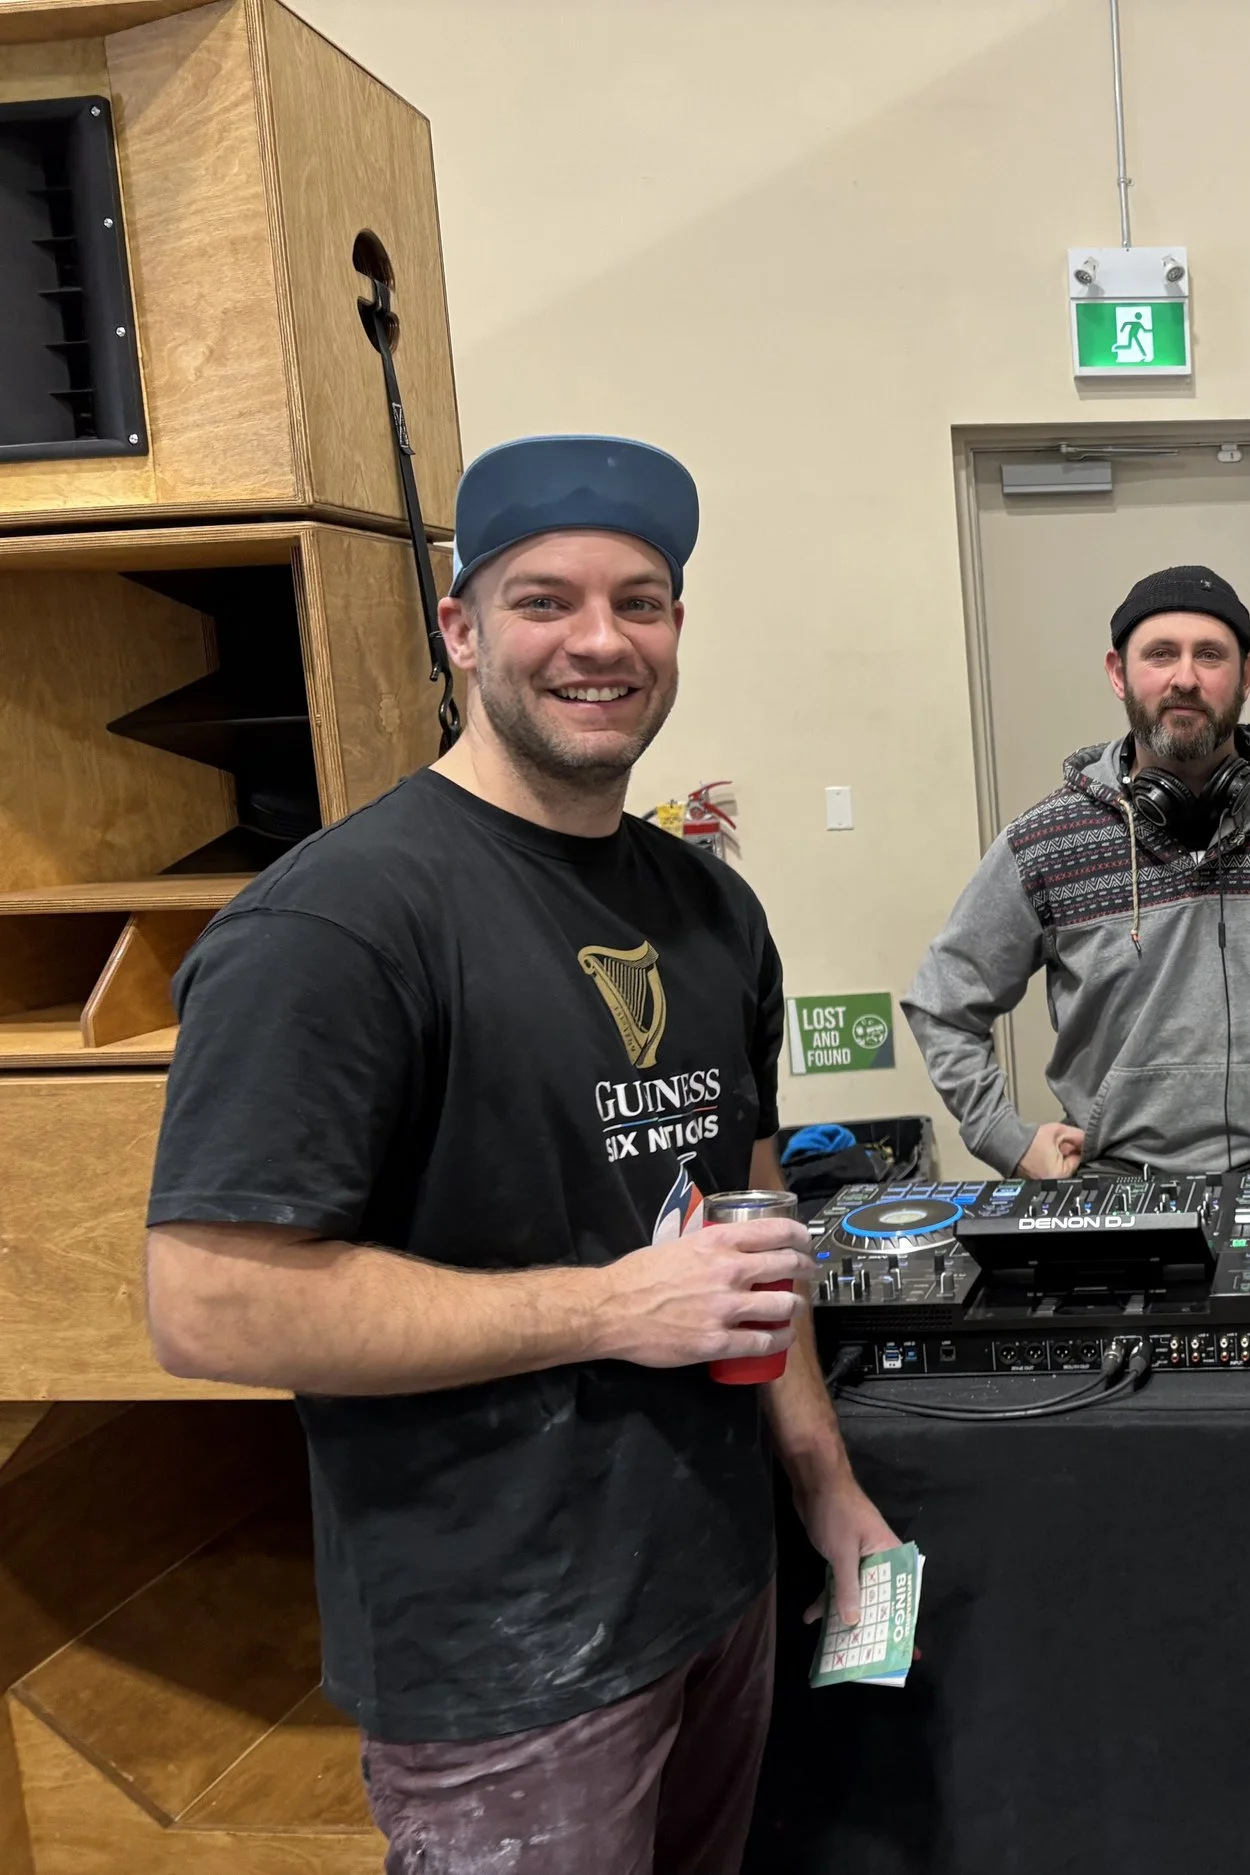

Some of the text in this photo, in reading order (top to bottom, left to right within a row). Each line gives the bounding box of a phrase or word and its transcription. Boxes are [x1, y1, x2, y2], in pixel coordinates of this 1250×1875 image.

[803, 1007, 846, 1030] LOST
[813, 1031, 840, 1048] AND
[807, 1048, 851, 1067] FOUND
[606, 1131, 639, 1162] SIX
[1019, 1215, 1135, 1230] DENON DJ
[893, 1573, 906, 1643] BINGO
